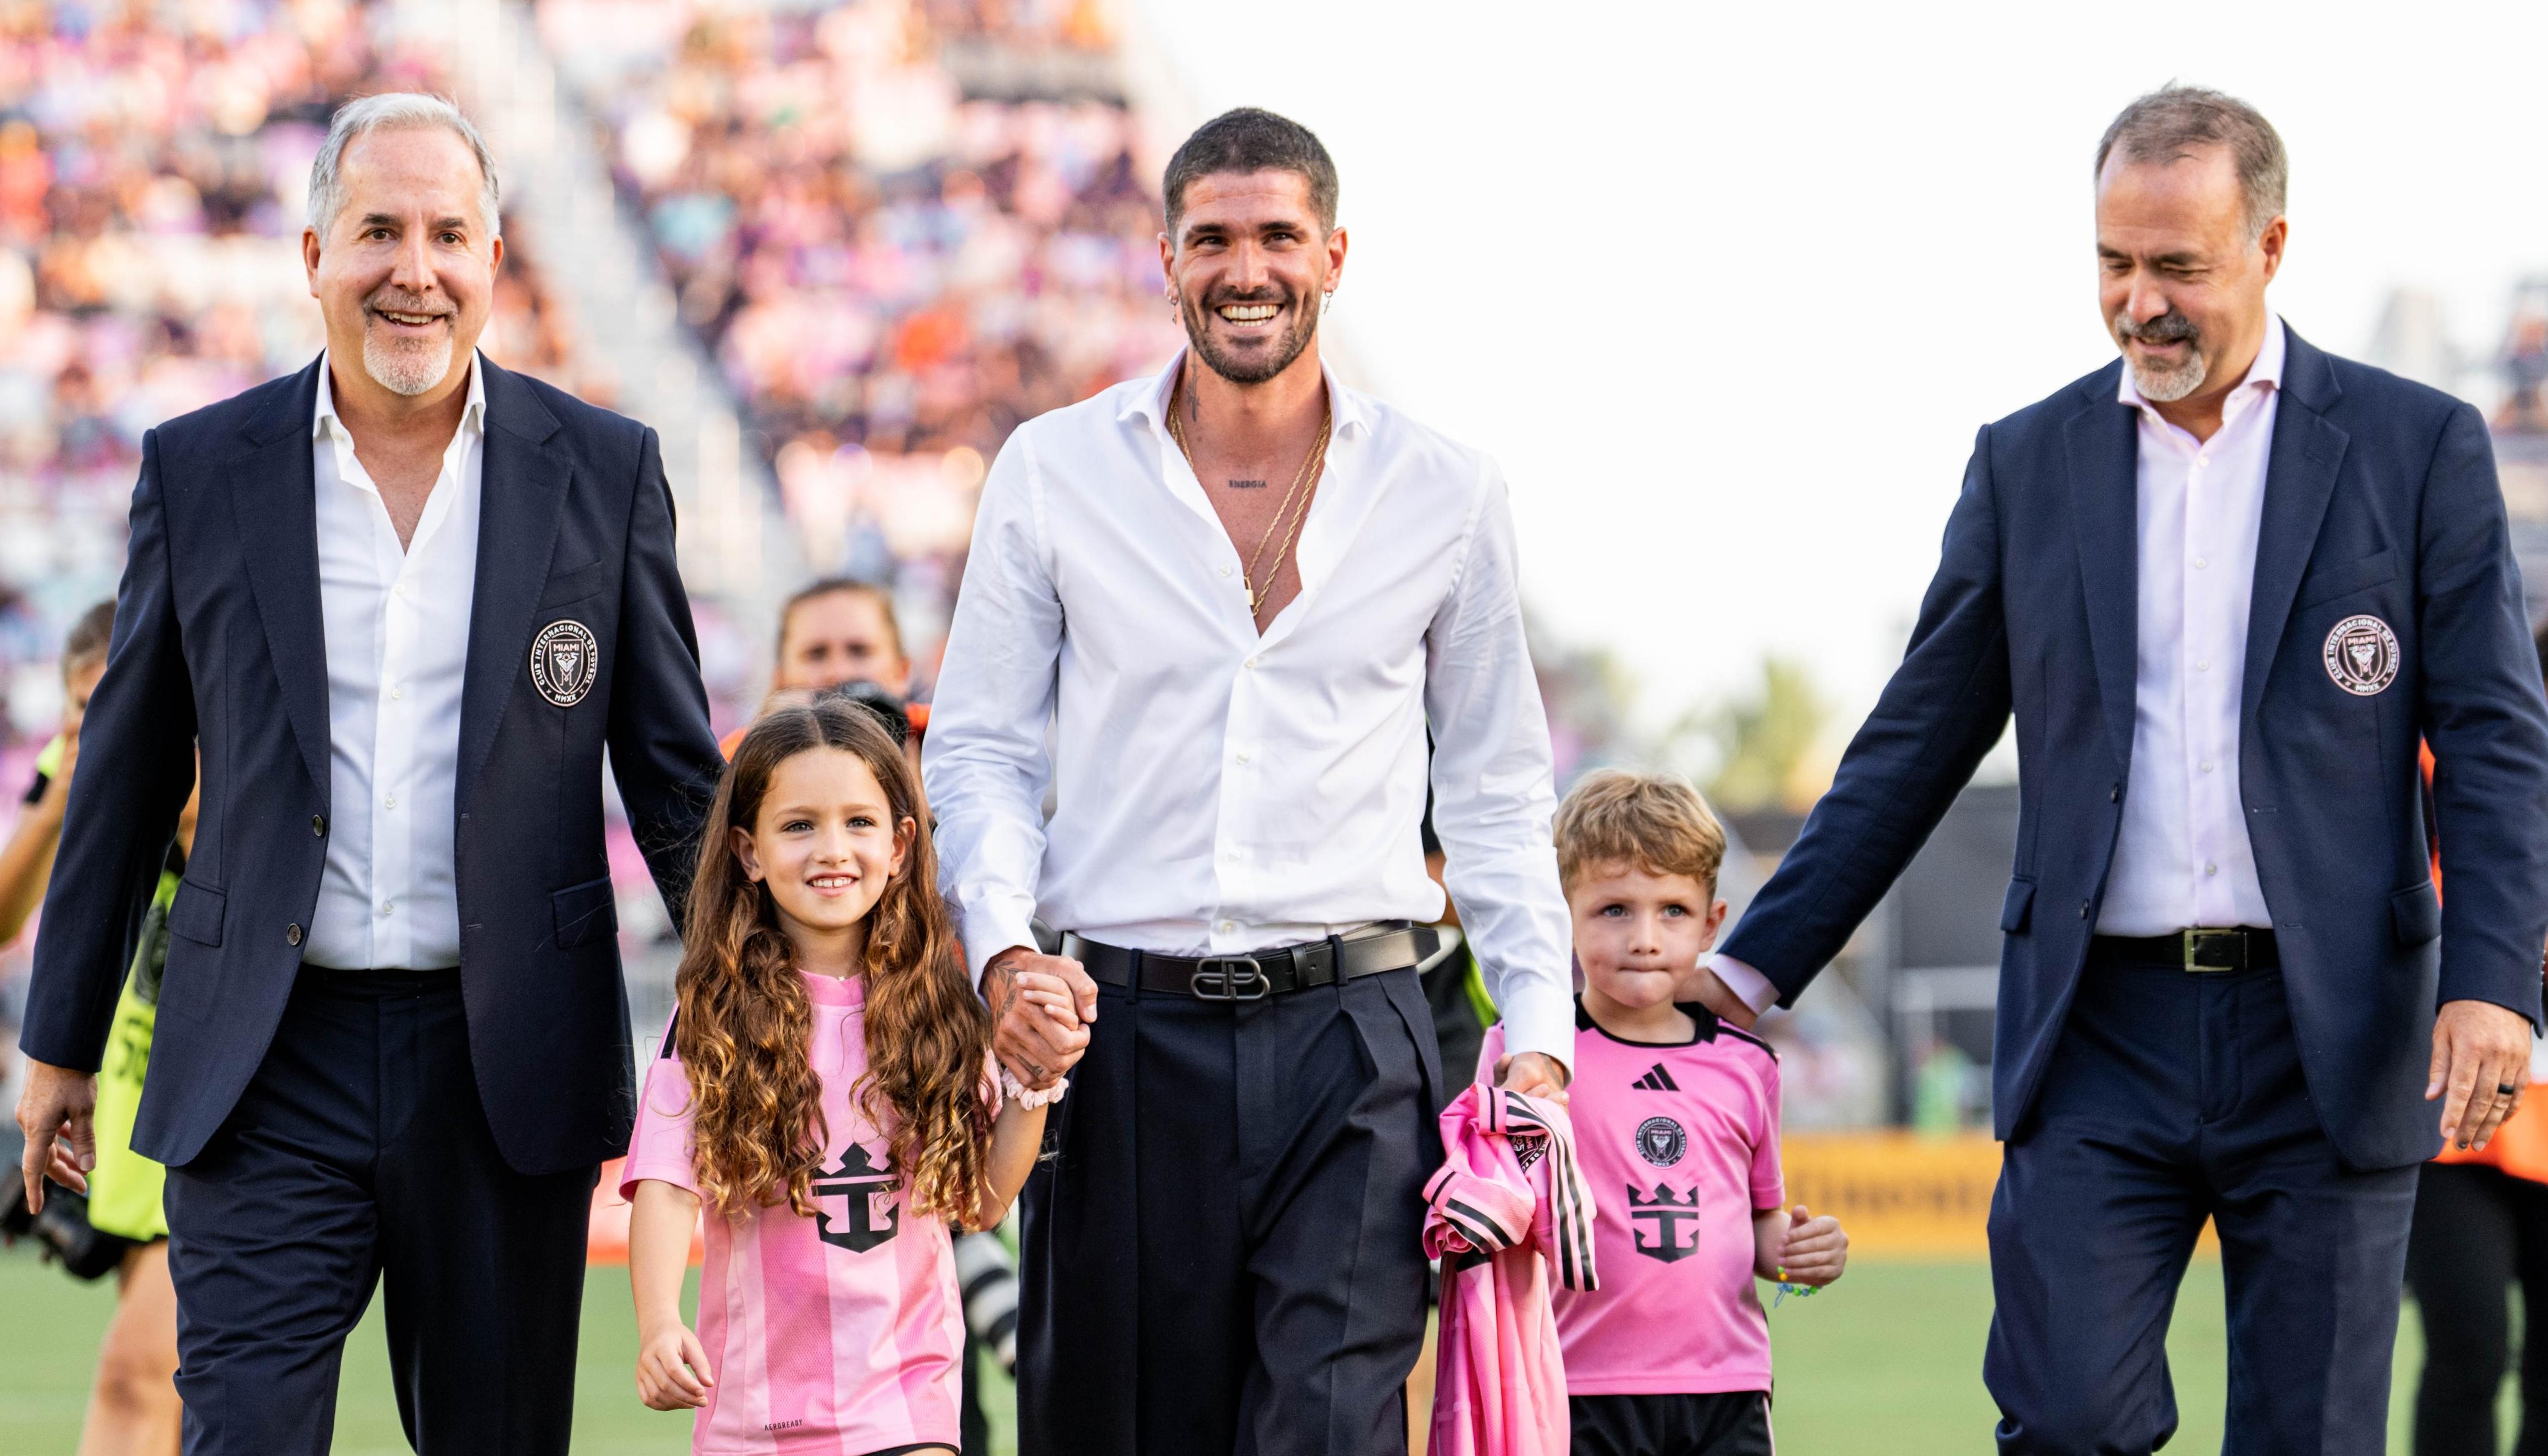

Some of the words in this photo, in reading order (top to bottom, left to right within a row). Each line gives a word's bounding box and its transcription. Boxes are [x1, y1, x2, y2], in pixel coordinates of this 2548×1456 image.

[2328, 618, 2382, 655] INTERNACIONAL
[2347, 635, 2376, 646] MIAMI
[2382, 629, 2392, 641] DE
[534, 625, 587, 660] INTERNACIONAL
[553, 644, 579, 652] MIAMI
[587, 639, 594, 651] DE
[2328, 657, 2343, 679] CLUB
[534, 664, 545, 686] CLUB
[2355, 683, 2380, 692] MMXX
[554, 694, 577, 702] MMXX
[764, 1419, 802, 1431] AEROREADY
